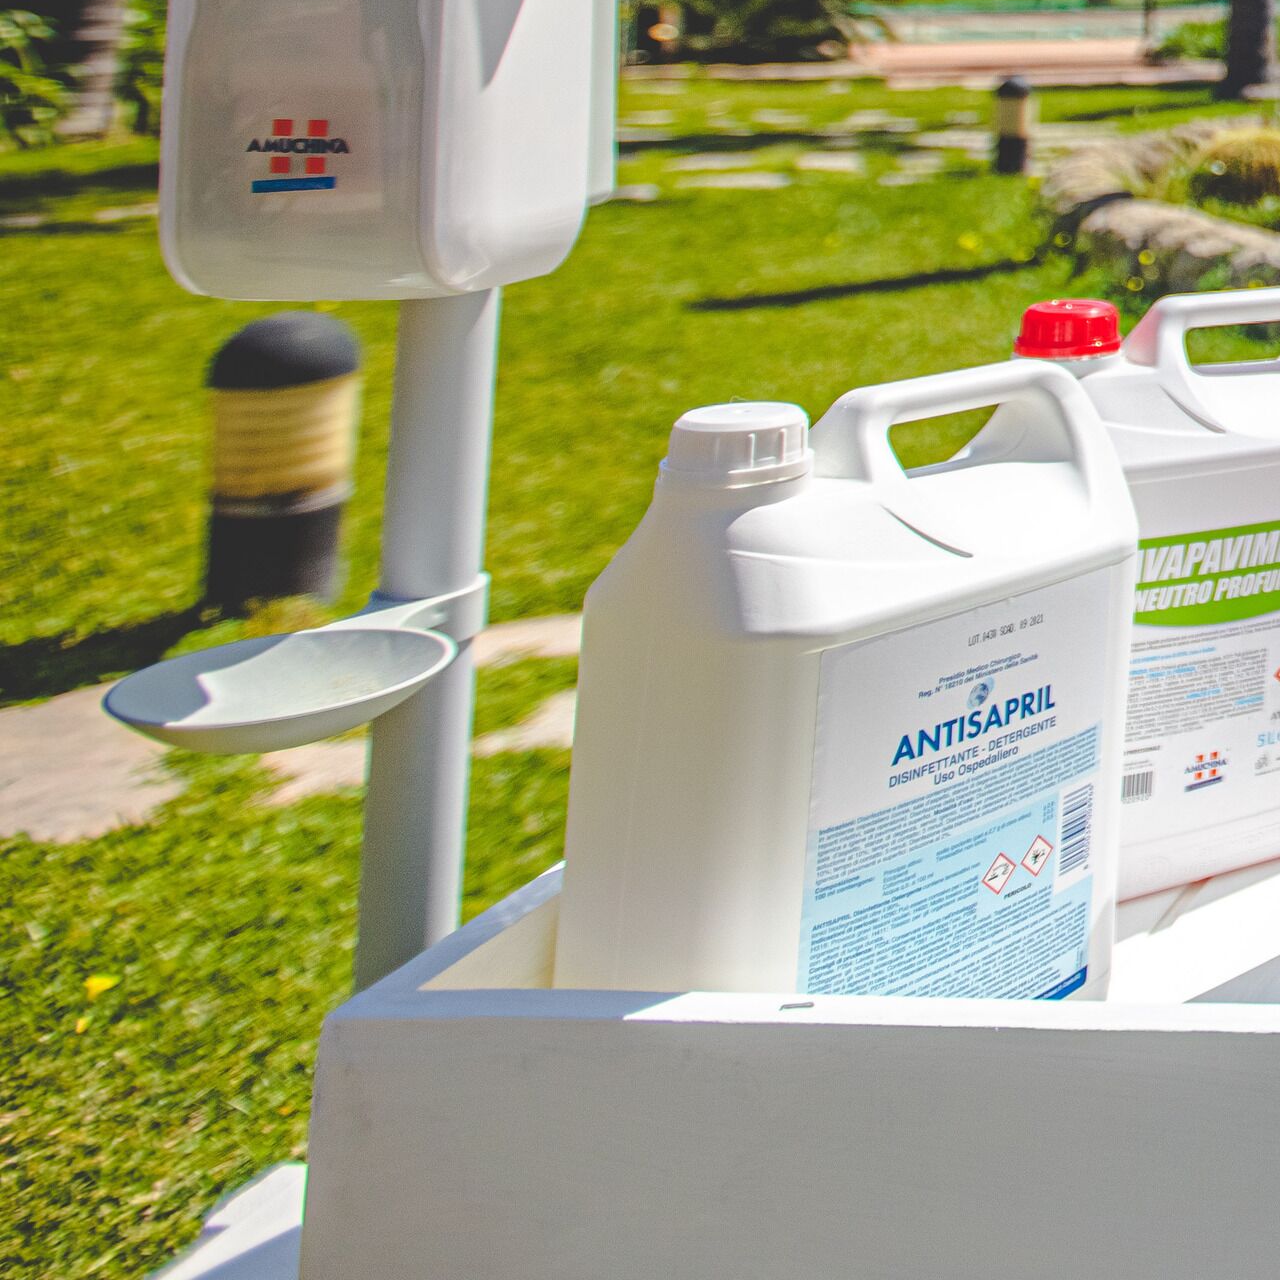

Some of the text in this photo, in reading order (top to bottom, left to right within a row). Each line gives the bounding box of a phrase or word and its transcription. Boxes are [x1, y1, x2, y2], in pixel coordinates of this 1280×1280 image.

[1135, 580, 1214, 612] NEUTRO
[891, 684, 1055, 767] ANTISAPRIL
[888, 746, 979, 788] DISINFETTANTE
[988, 716, 1056, 752] DETERGENTE
[934, 746, 1019, 785] Uso Ospedaliero
[1184, 758, 1227, 775] AMUCHINA
